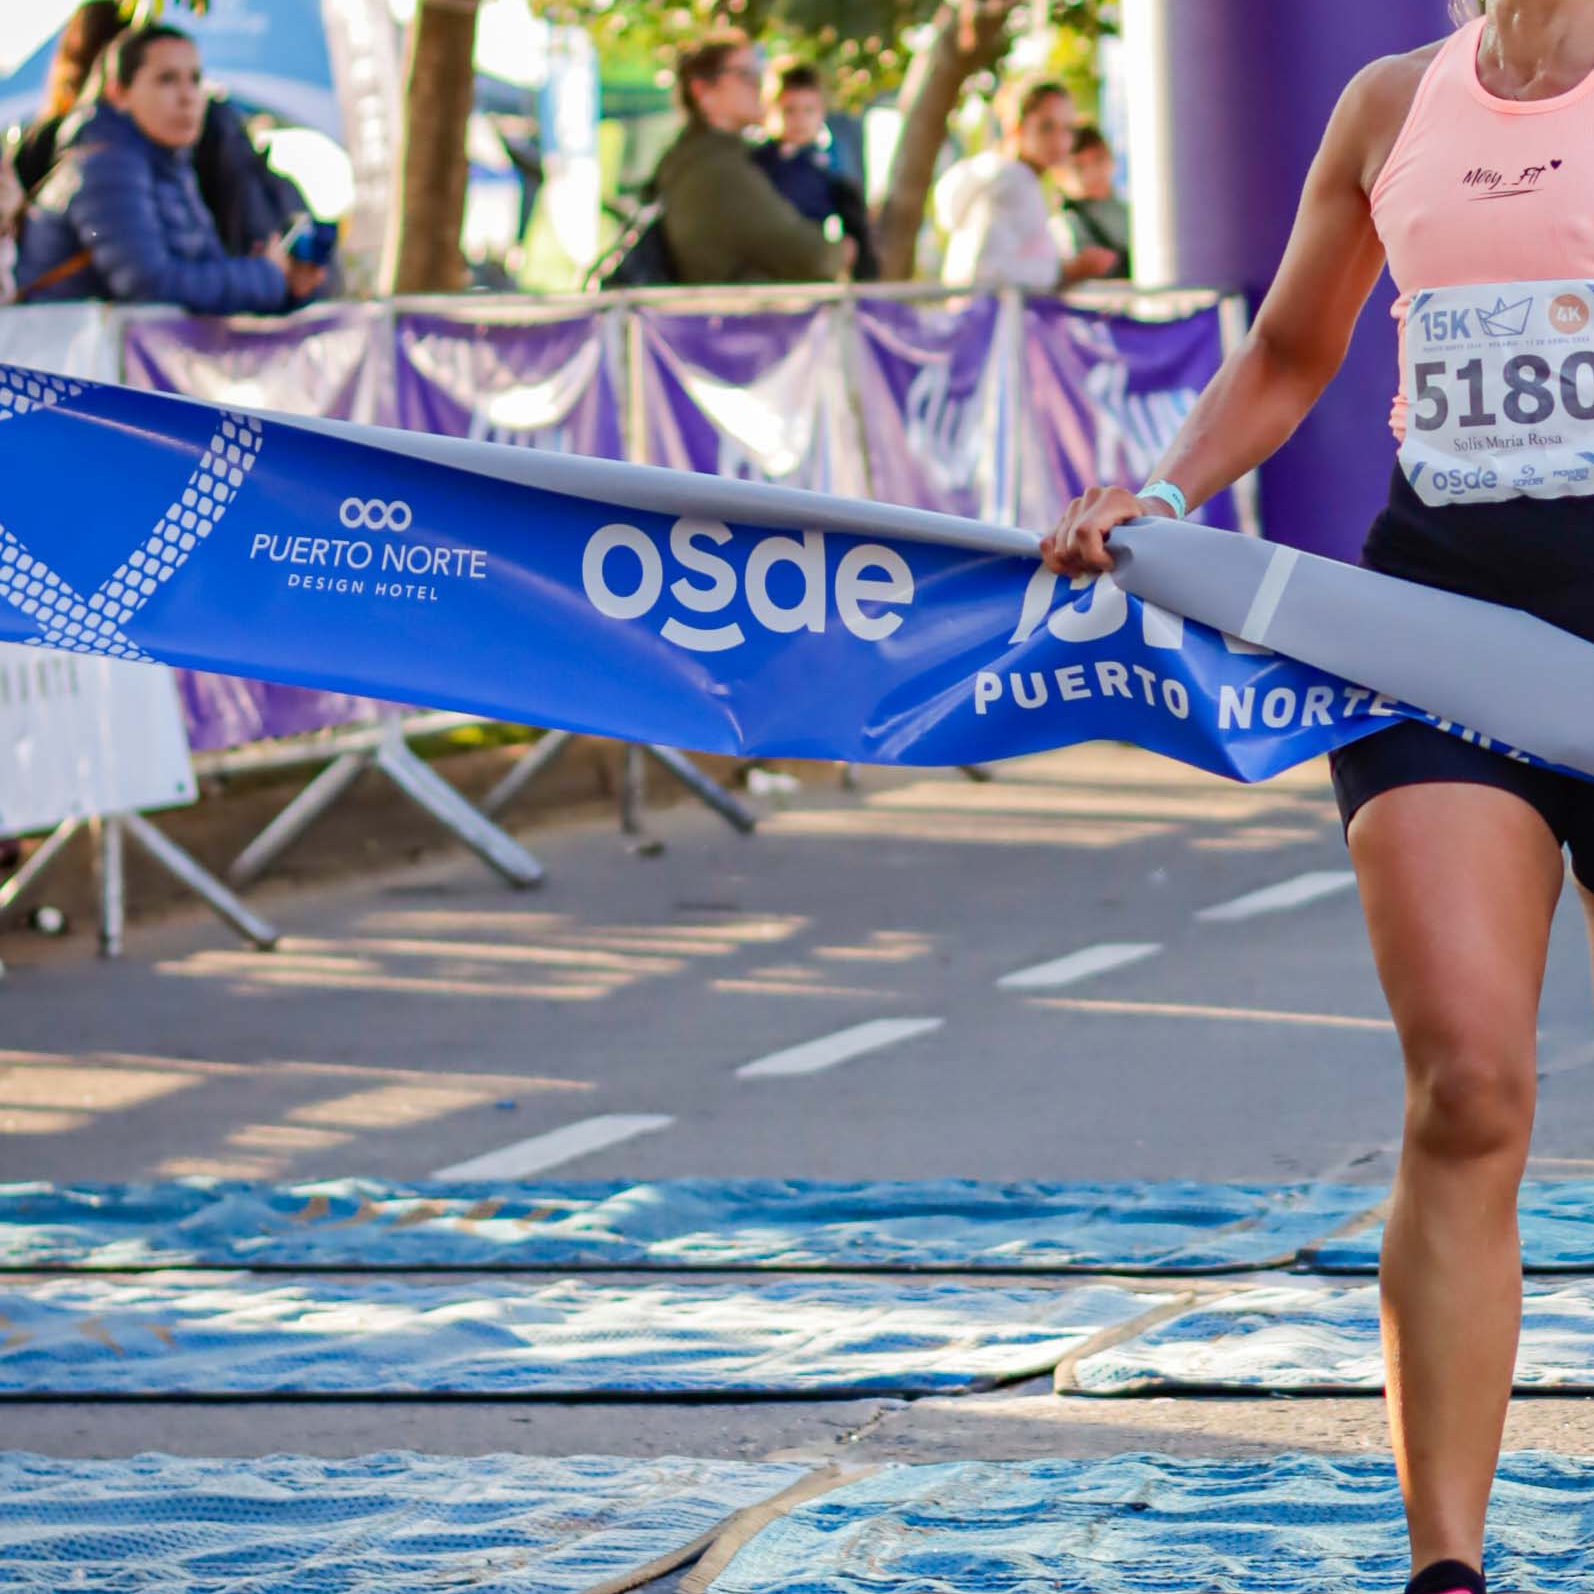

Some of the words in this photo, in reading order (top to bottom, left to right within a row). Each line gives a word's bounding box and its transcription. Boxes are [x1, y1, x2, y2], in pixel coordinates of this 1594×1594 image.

[1419, 308, 1472, 342] 15K
[1555, 305, 1583, 323] 4K
[1528, 432, 1563, 446] Rosa
[1431, 465, 1498, 494] osde
[249, 533, 376, 571] PUERTO
[382, 543, 488, 579] NORTE
[287, 572, 365, 596] DESIGN
[375, 583, 440, 602] HOTEL
[974, 661, 1190, 720] PUERTO
[1217, 685, 1404, 730] NORTE
